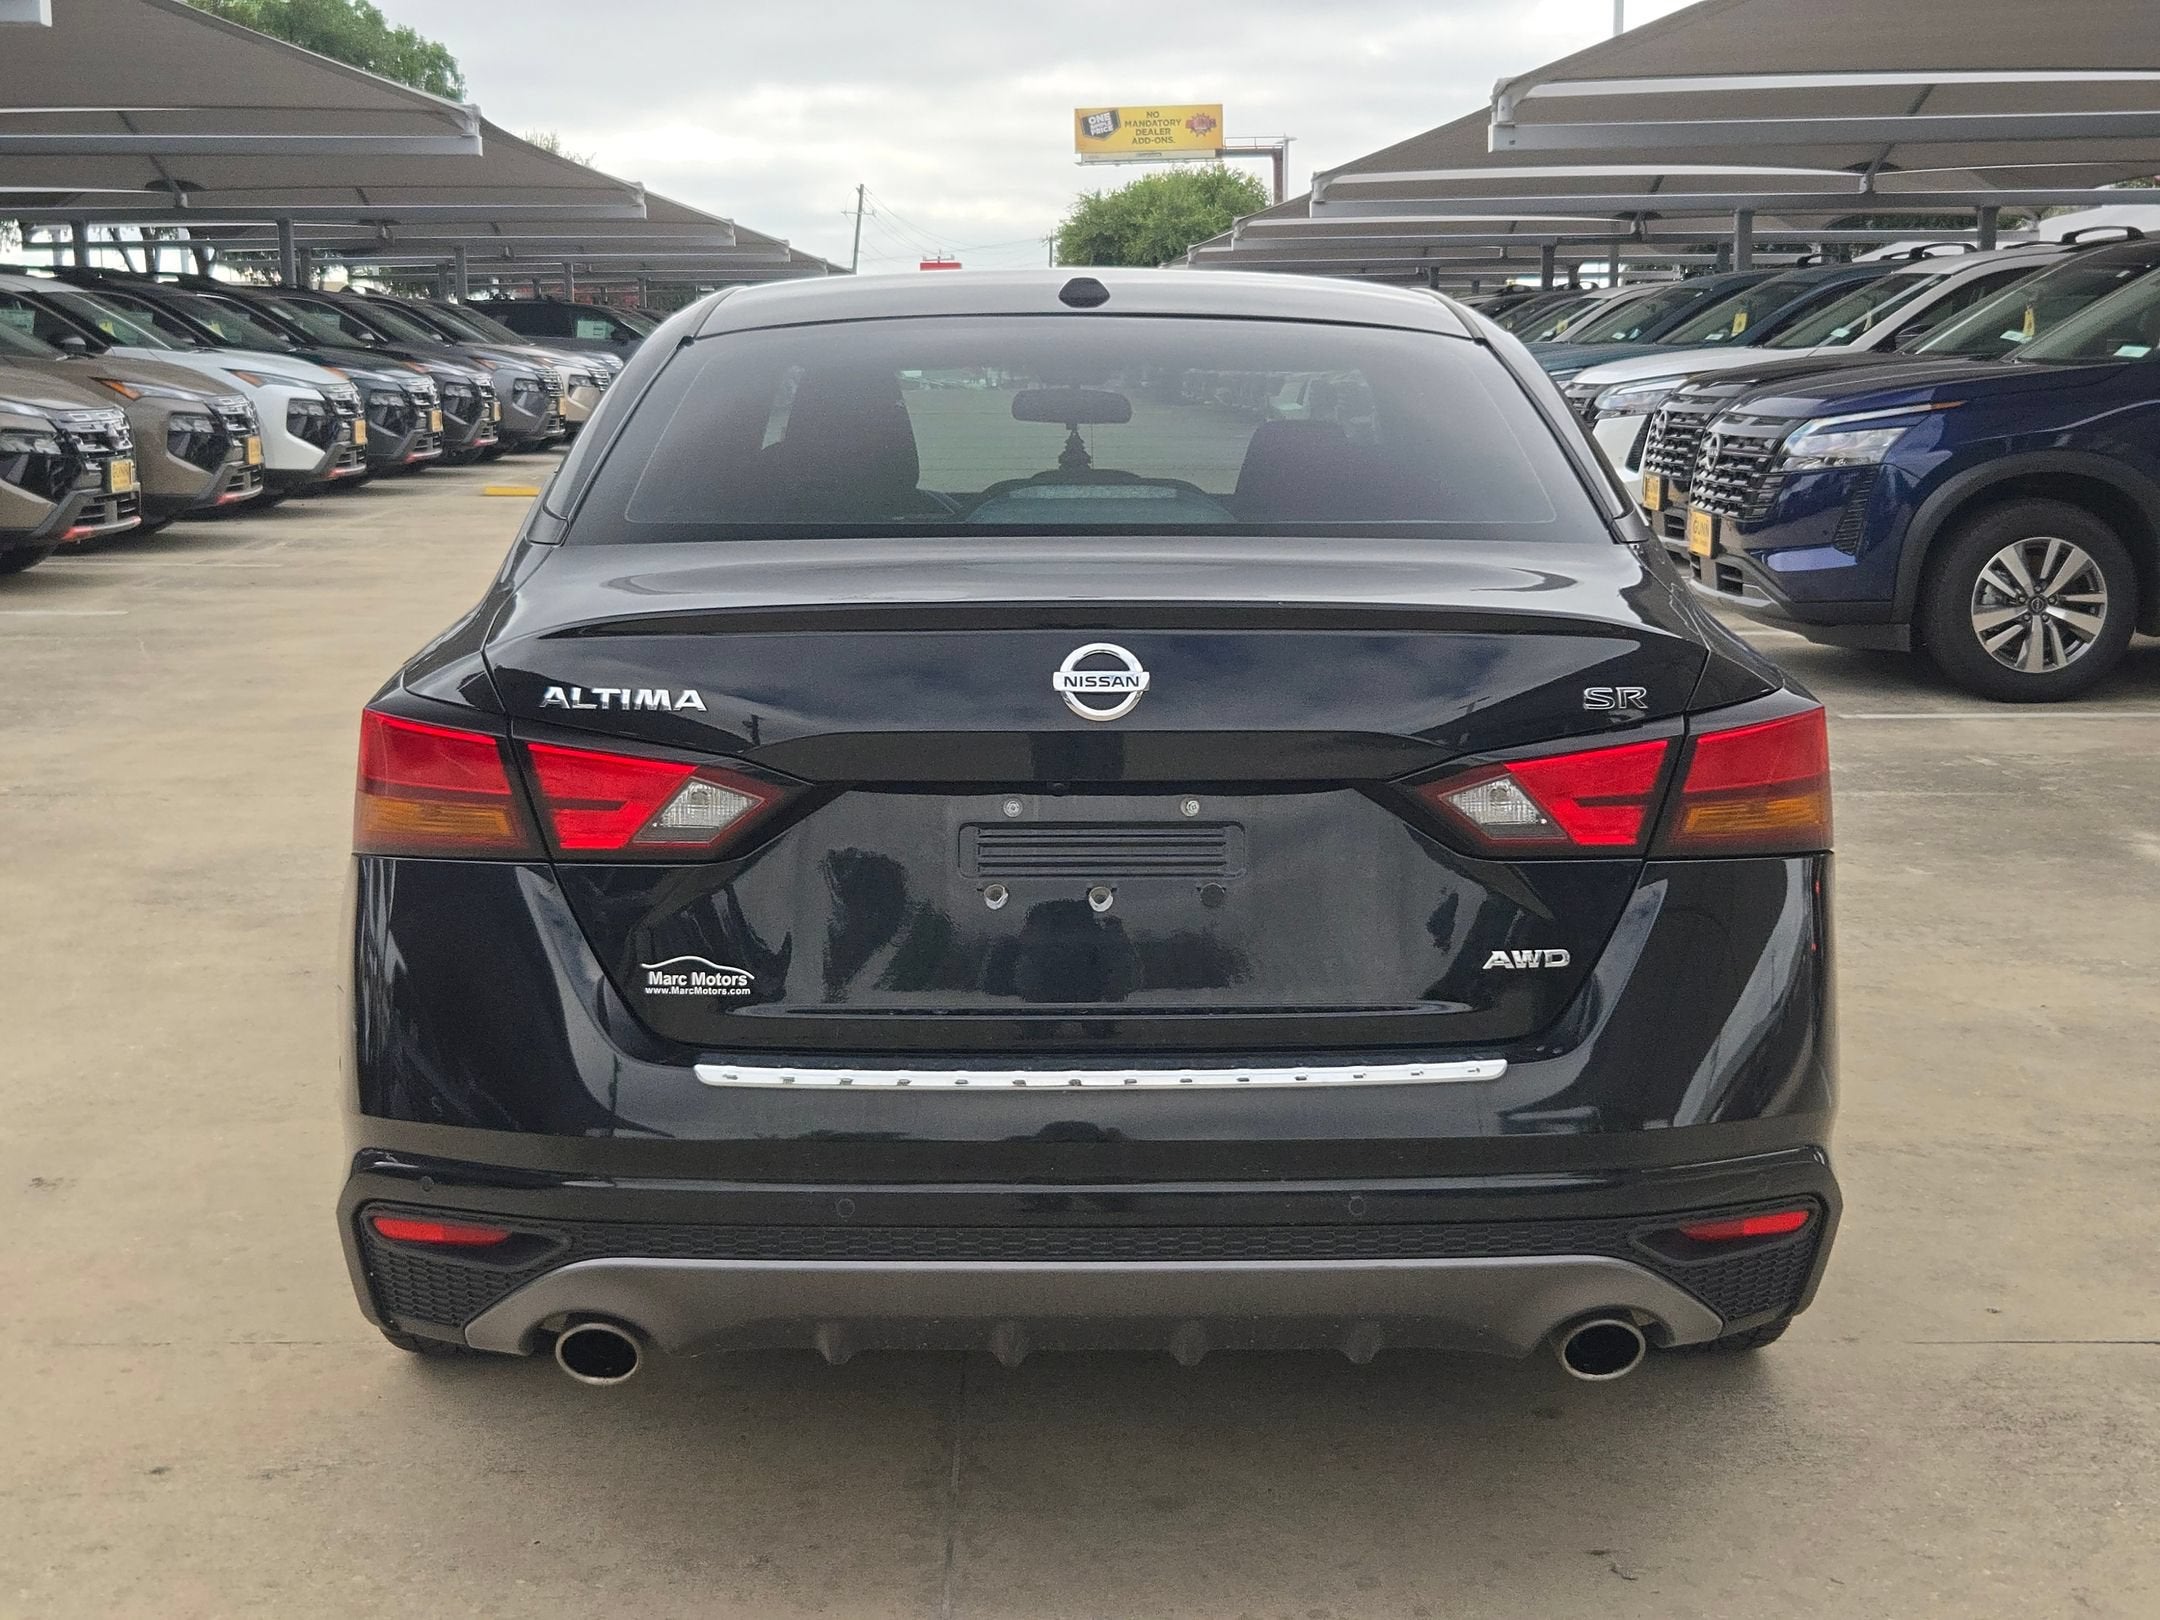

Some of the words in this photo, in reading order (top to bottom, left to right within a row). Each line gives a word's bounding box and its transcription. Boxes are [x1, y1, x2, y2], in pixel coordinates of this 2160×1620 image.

[1088, 112, 1111, 124] ONE
[1146, 111, 1160, 119] NO
[1124, 118, 1181, 128] MANDATORY
[1090, 125, 1114, 136] PRICE
[1135, 127, 1171, 136] DEALER
[1131, 136, 1176, 145] ADD-ONS.
[1063, 675, 1140, 688] NISSAN
[538, 686, 707, 711] ALTIMA
[1583, 686, 1648, 710] SR
[1482, 948, 1571, 970] AWD
[648, 971, 688, 986] Marc
[691, 971, 748, 986] Motors
[644, 986, 751, 995] www.MarcMotors.com
